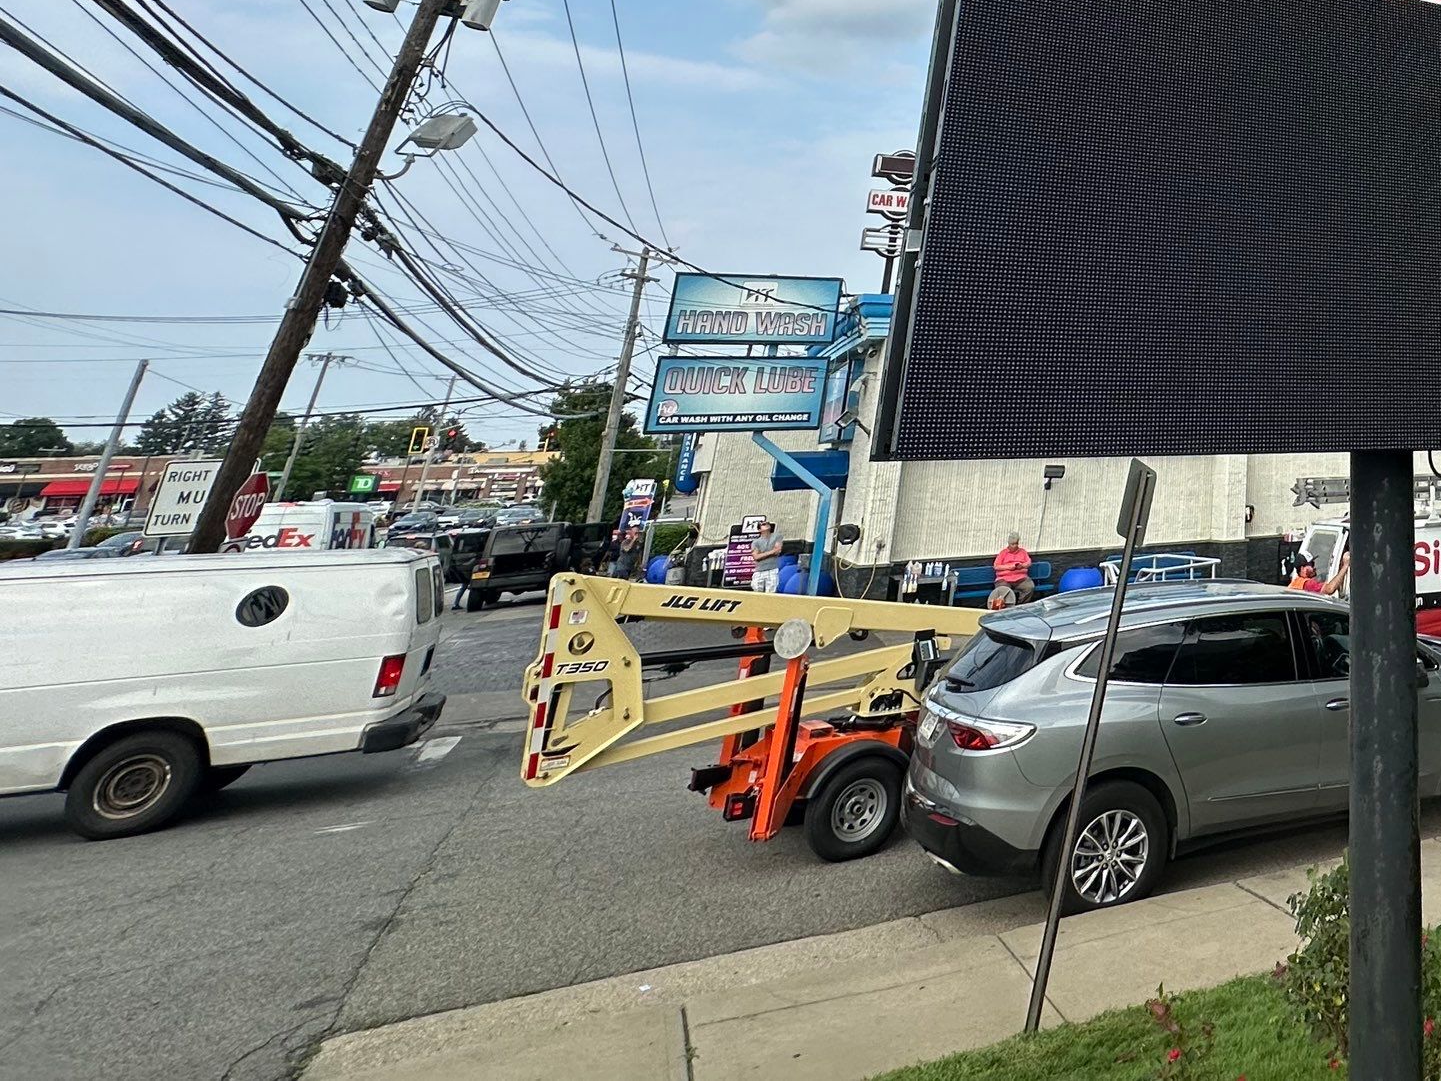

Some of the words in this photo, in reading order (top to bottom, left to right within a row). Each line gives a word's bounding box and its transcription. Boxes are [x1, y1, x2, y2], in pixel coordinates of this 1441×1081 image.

[871, 193, 894, 207] CAR
[676, 309, 749, 335] HAND
[755, 310, 828, 337] WASH
[663, 366, 749, 395] QUICK
[753, 366, 819, 394] LUBE
[658, 416, 679, 424] CAR
[680, 415, 707, 423] WASH
[709, 415, 734, 423] WITH
[755, 414, 771, 422] OIL
[772, 413, 809, 421] CHANGE
[167, 470, 212, 483] RIGHT
[357, 479, 372, 489] TD
[176, 490, 207, 505] MU
[230, 492, 266, 521] STOP
[152, 513, 192, 527] TURN
[245, 528, 316, 549] edEx
[660, 595, 700, 609] JLG
[698, 598, 742, 613] LIFT
[555, 660, 610, 675] T350
